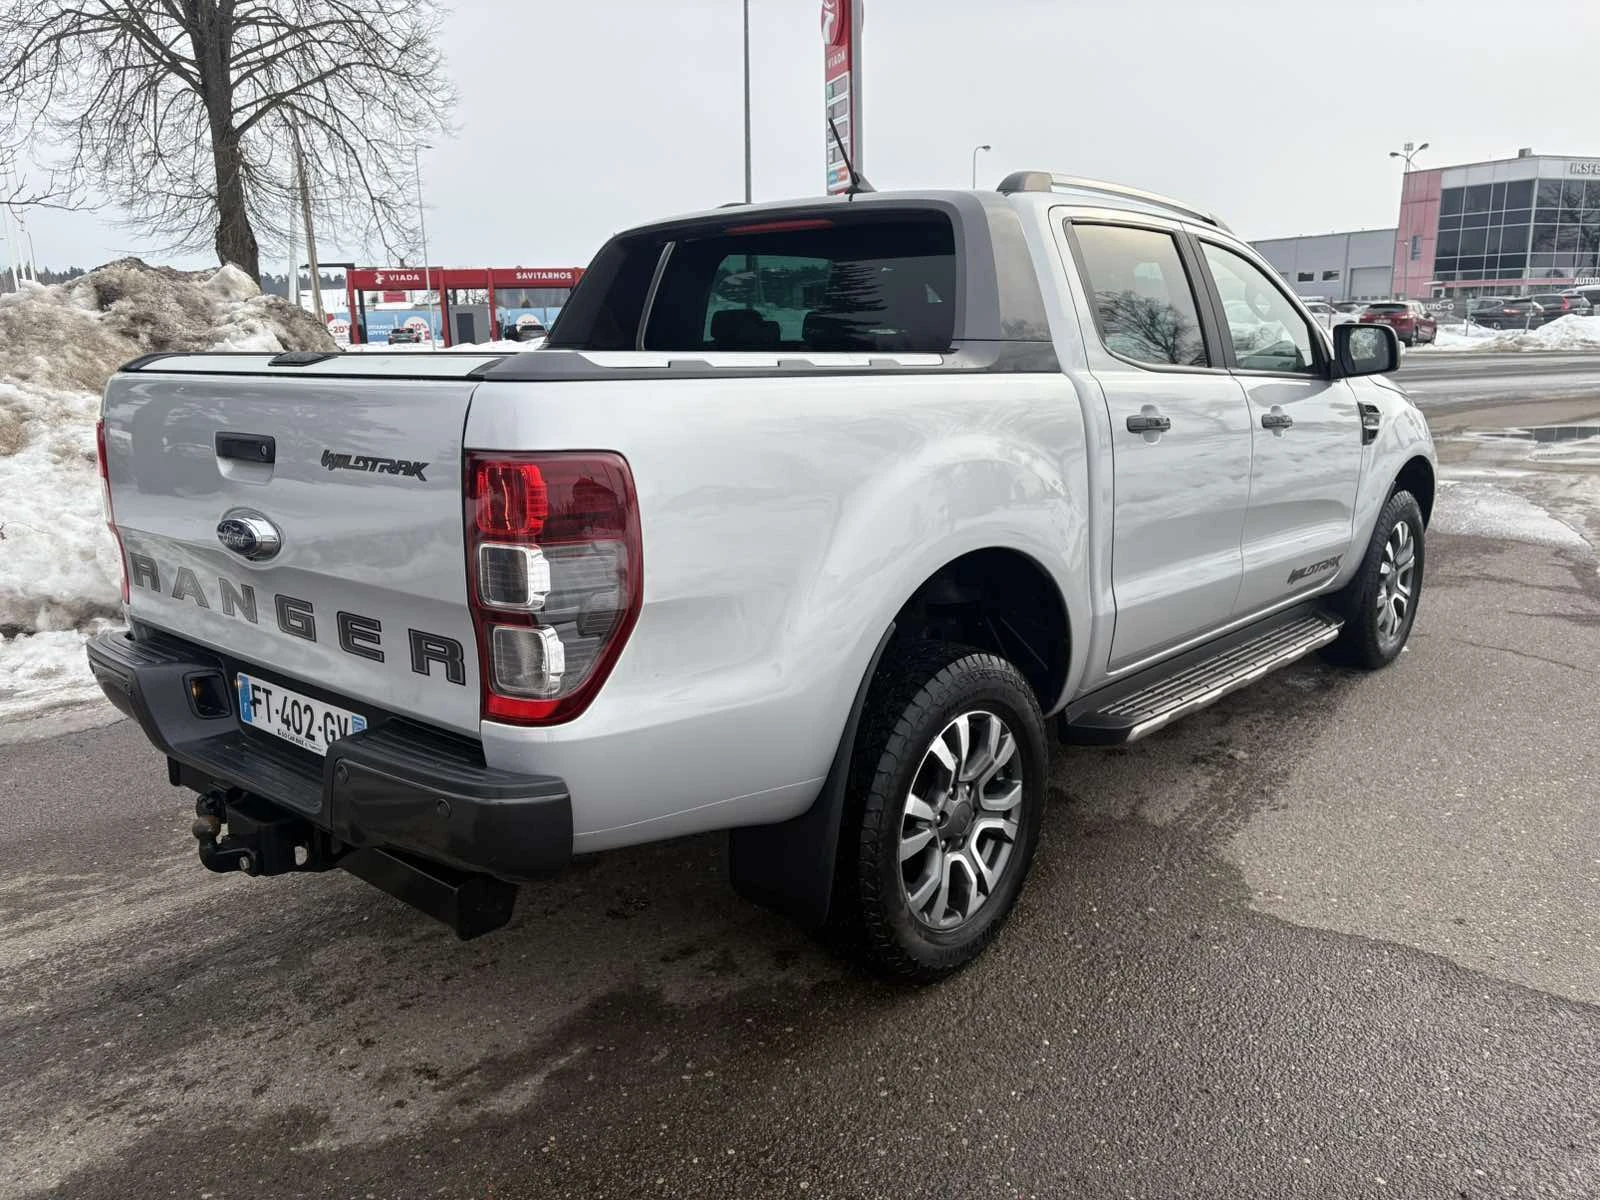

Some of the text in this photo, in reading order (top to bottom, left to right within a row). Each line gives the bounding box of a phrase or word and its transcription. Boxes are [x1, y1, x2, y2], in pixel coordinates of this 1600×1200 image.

[516, 272, 572, 280] SAVITARNOS
[320, 449, 430, 482] WILDTRAK
[222, 524, 245, 546] Ford
[129, 552, 466, 686] RANGER
